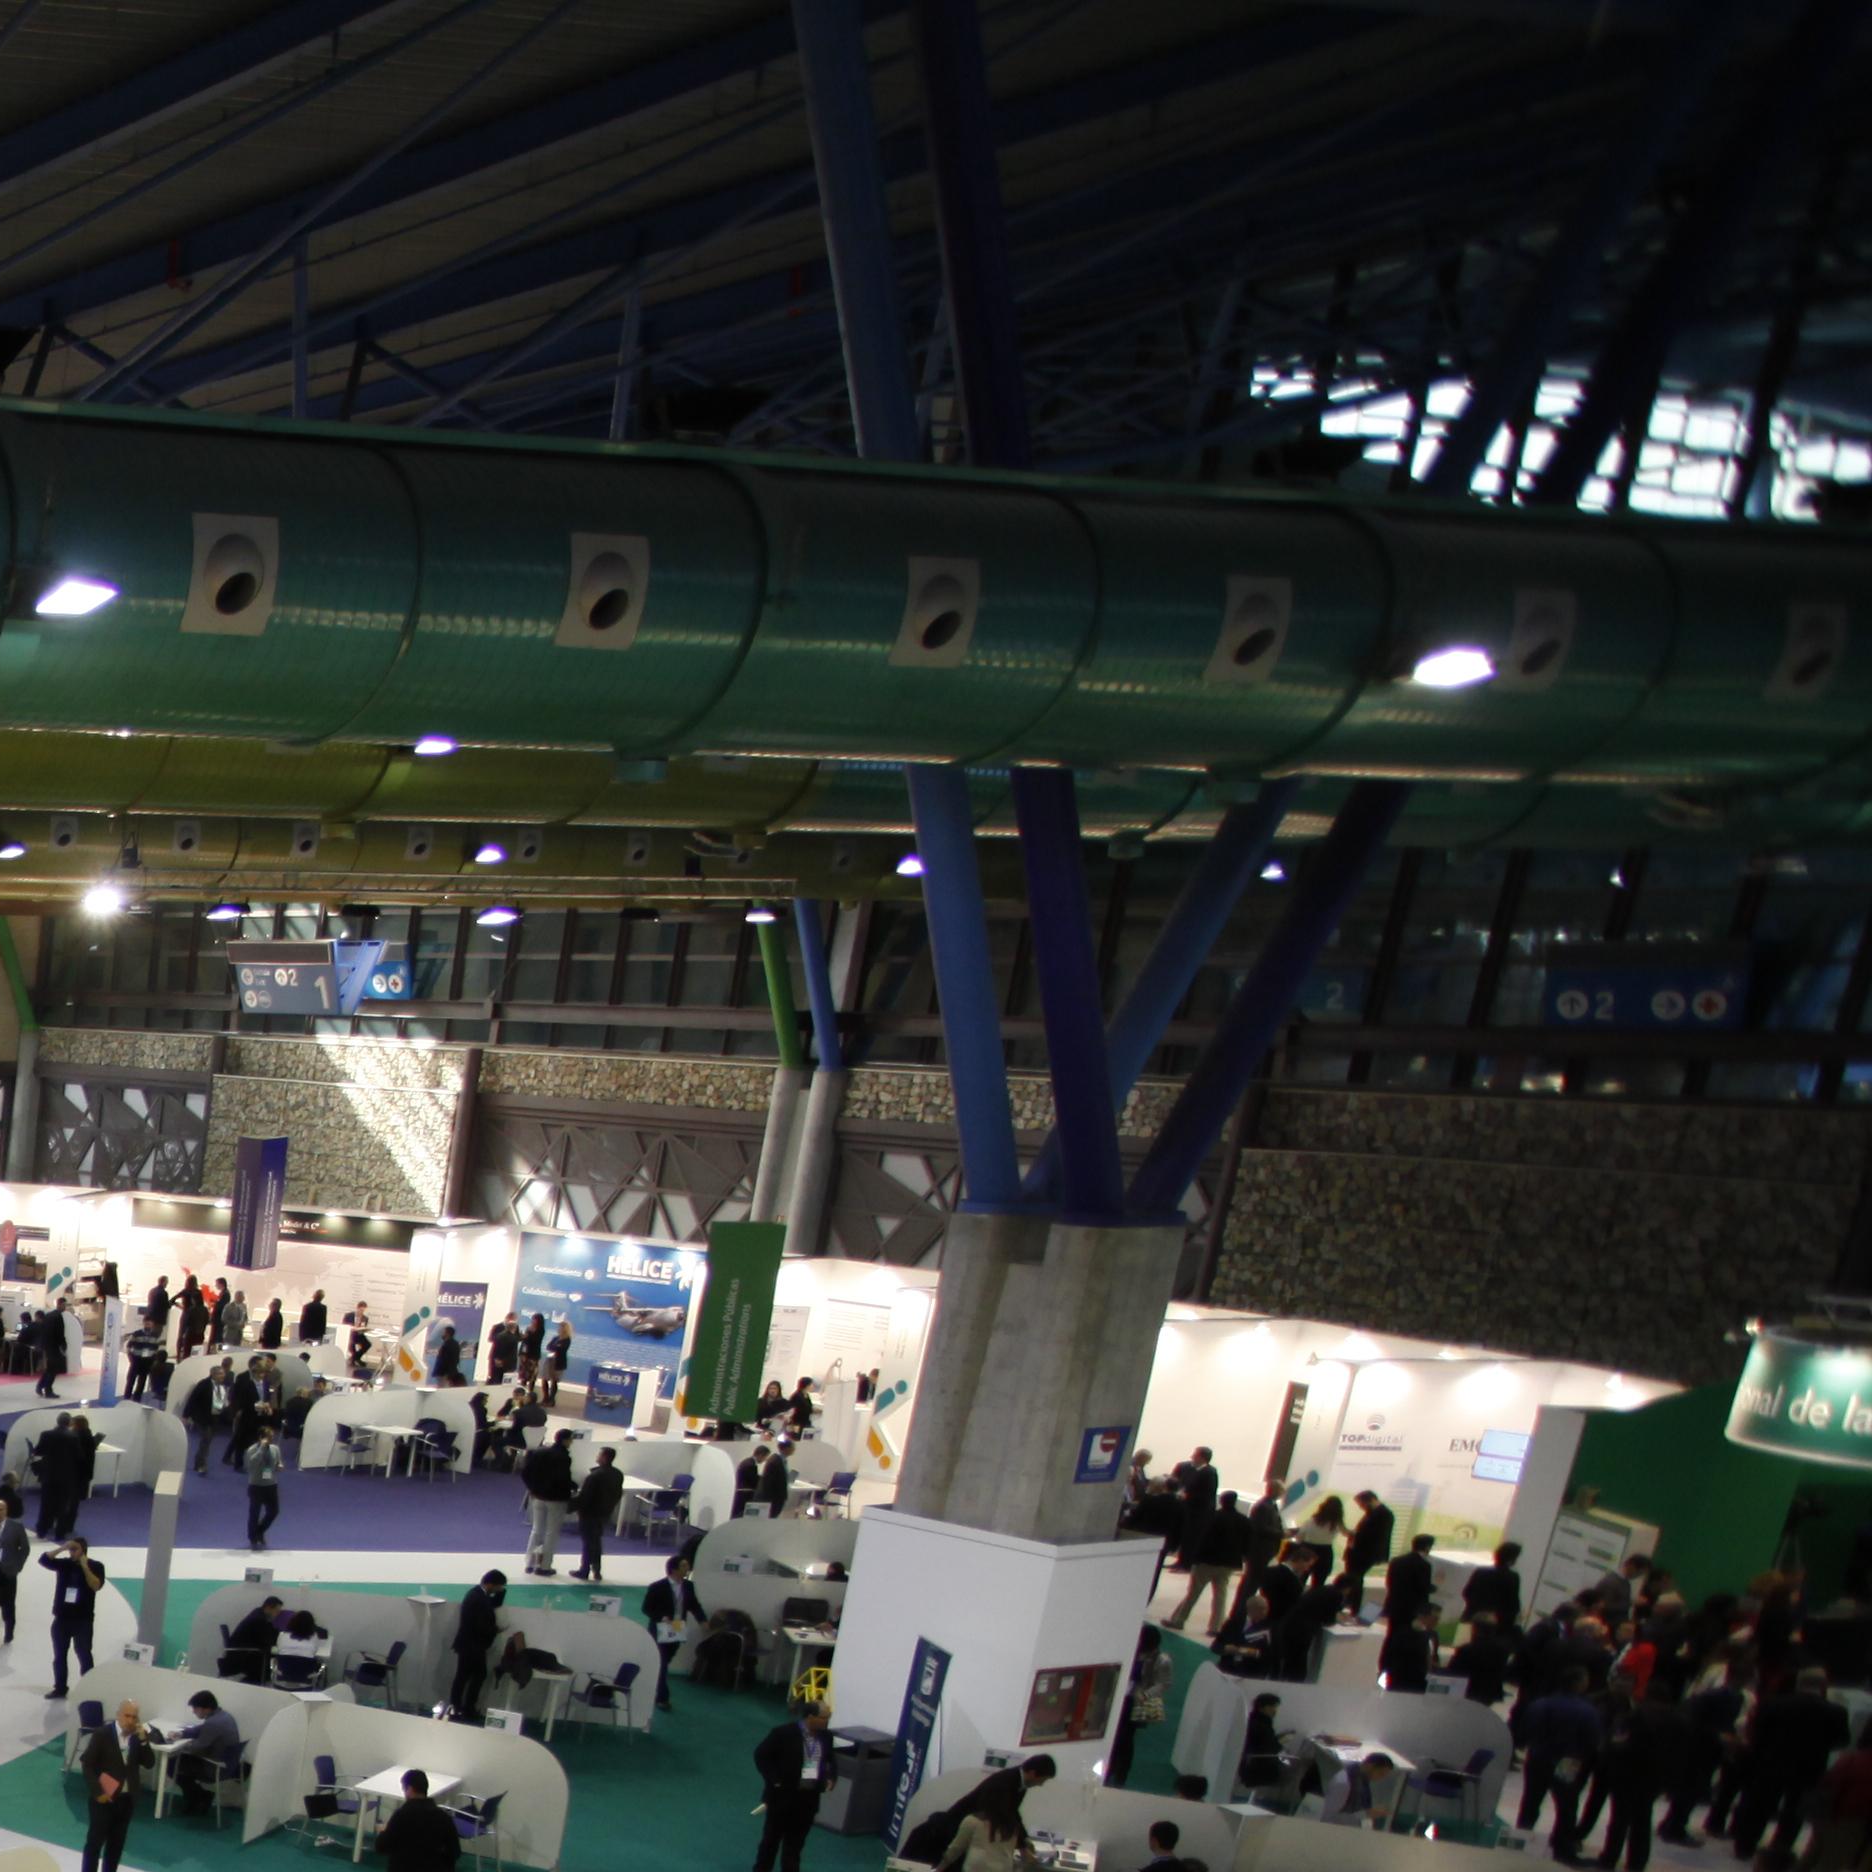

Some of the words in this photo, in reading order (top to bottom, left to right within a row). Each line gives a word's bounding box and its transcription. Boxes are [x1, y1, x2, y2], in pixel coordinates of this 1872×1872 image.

[709, 1323, 732, 1414] Administraciones
[723, 1278, 740, 1322] Públicas
[730, 1303, 752, 1383] Administrations
[723, 1385, 738, 1416] Public
[1788, 1386, 1833, 1430] de
[1341, 1433, 1404, 1446] TOPdigital
